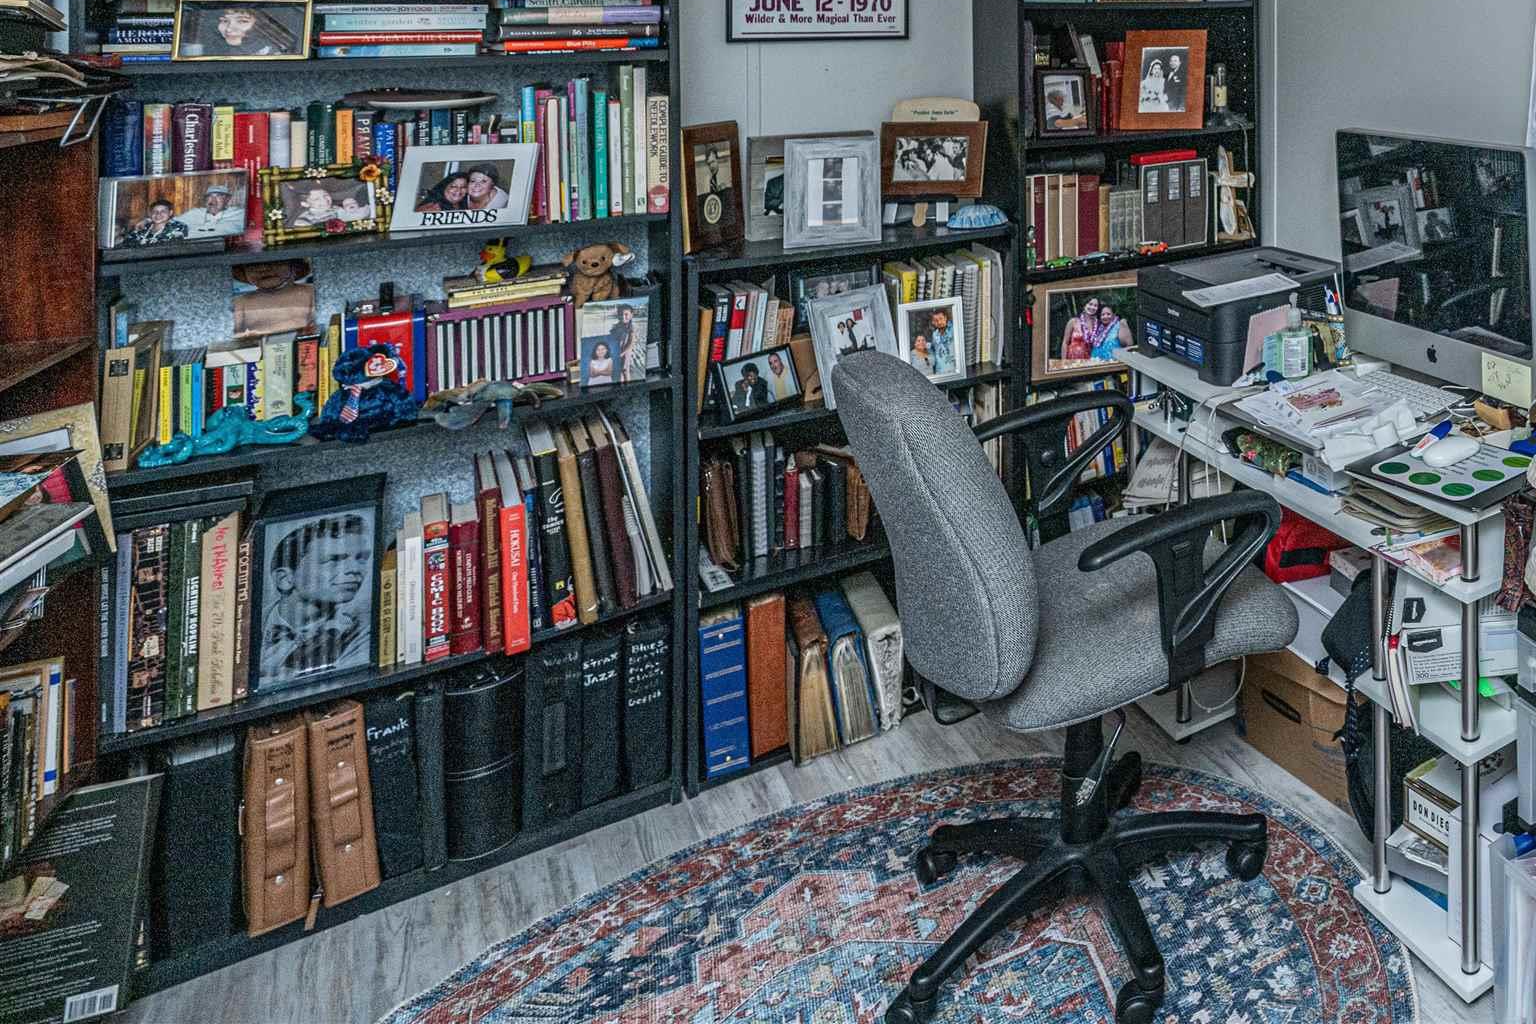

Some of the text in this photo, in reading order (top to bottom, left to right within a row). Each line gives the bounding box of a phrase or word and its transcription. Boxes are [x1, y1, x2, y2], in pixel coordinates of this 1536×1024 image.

[745, 14, 896, 25] Wilder & More Magical Than Ever
[649, 100, 658, 158] NEEDLEWORK
[659, 99, 668, 183] COMPLETE GUIDE TO
[421, 208, 498, 226] FRIENDS
[509, 528, 521, 568] HOKUSAI
[431, 607, 445, 634] BOOK
[1412, 799, 1429, 818] DON
